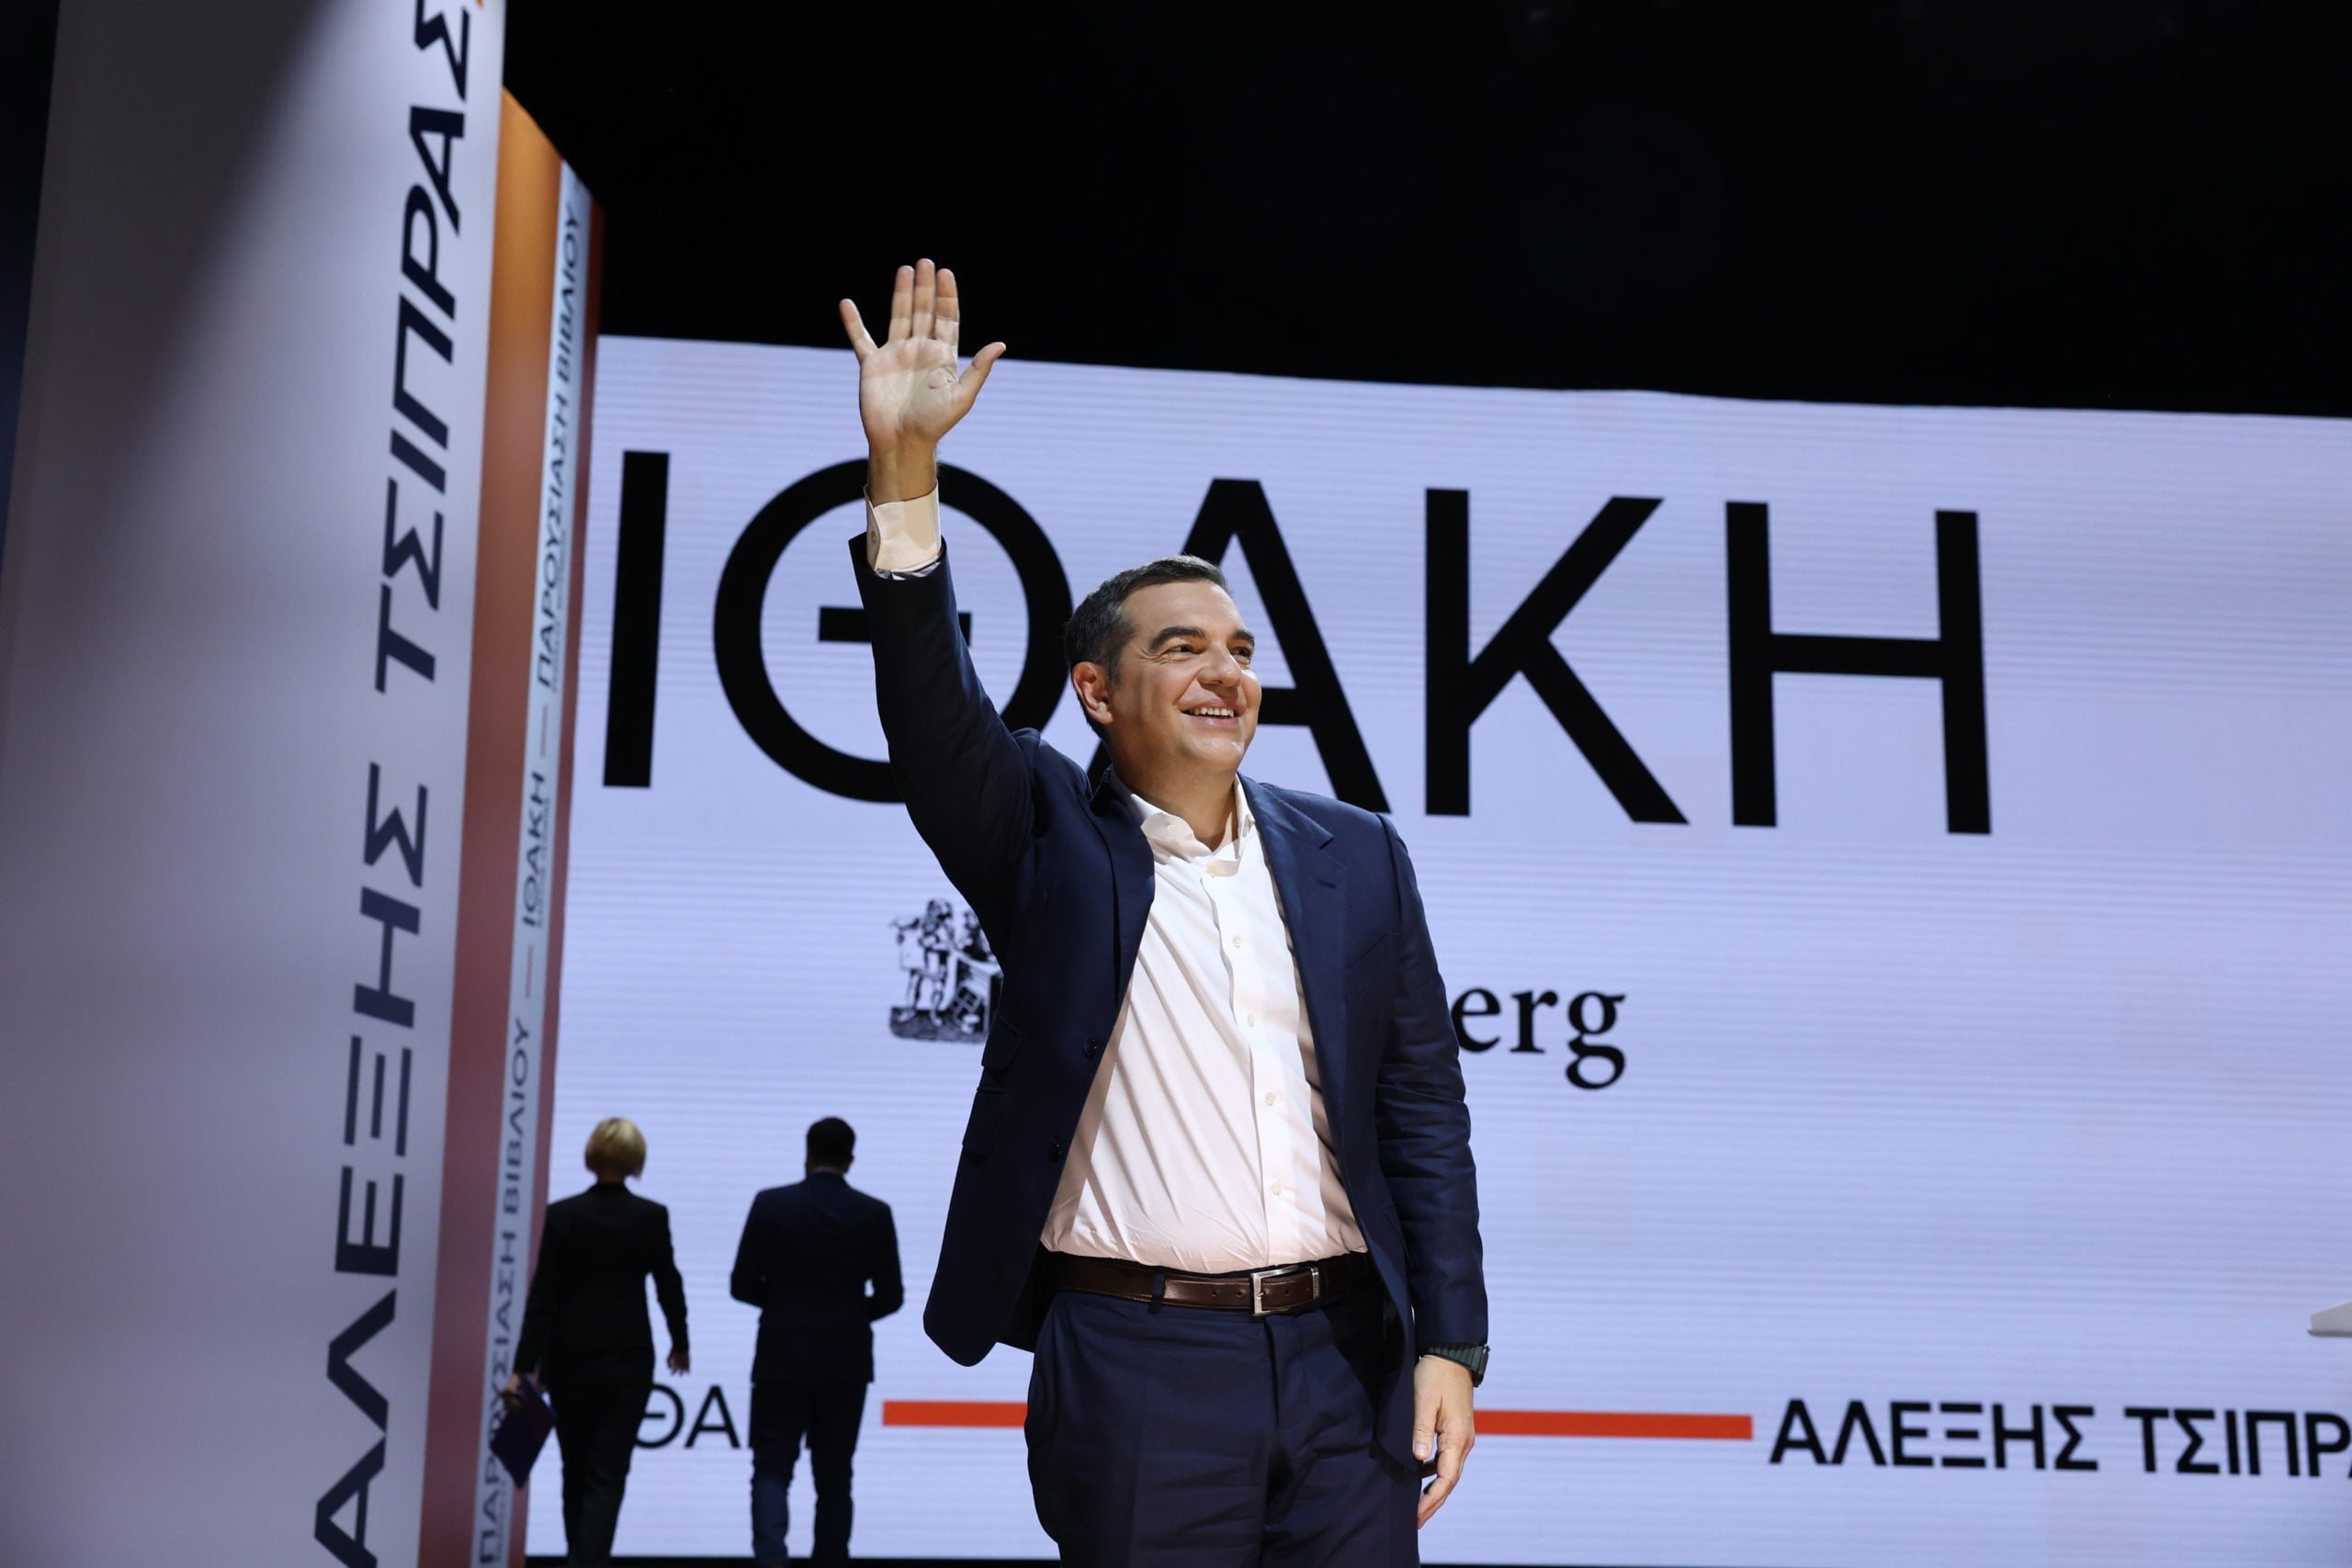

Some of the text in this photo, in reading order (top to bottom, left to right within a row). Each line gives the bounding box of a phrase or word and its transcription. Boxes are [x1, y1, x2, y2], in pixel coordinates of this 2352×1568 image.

[314, 0, 469, 1568] ΑΛΕΞΗΣ ΤΣΙΠΡΑΣ
[503, 1017, 528, 1214] ΒΙΒΛΙΟΥ
[537, 392, 568, 687] ΠΑΡΟΥΣΙΑΣΗ
[556, 199, 579, 383] ΒΙΒΛΙΟΥ
[603, 450, 1992, 836] ΙΘΑΚΗ
[1769, 1399, 2352, 1479] ΑΛΕΞΗΣ ΤΣΙΠΡ
